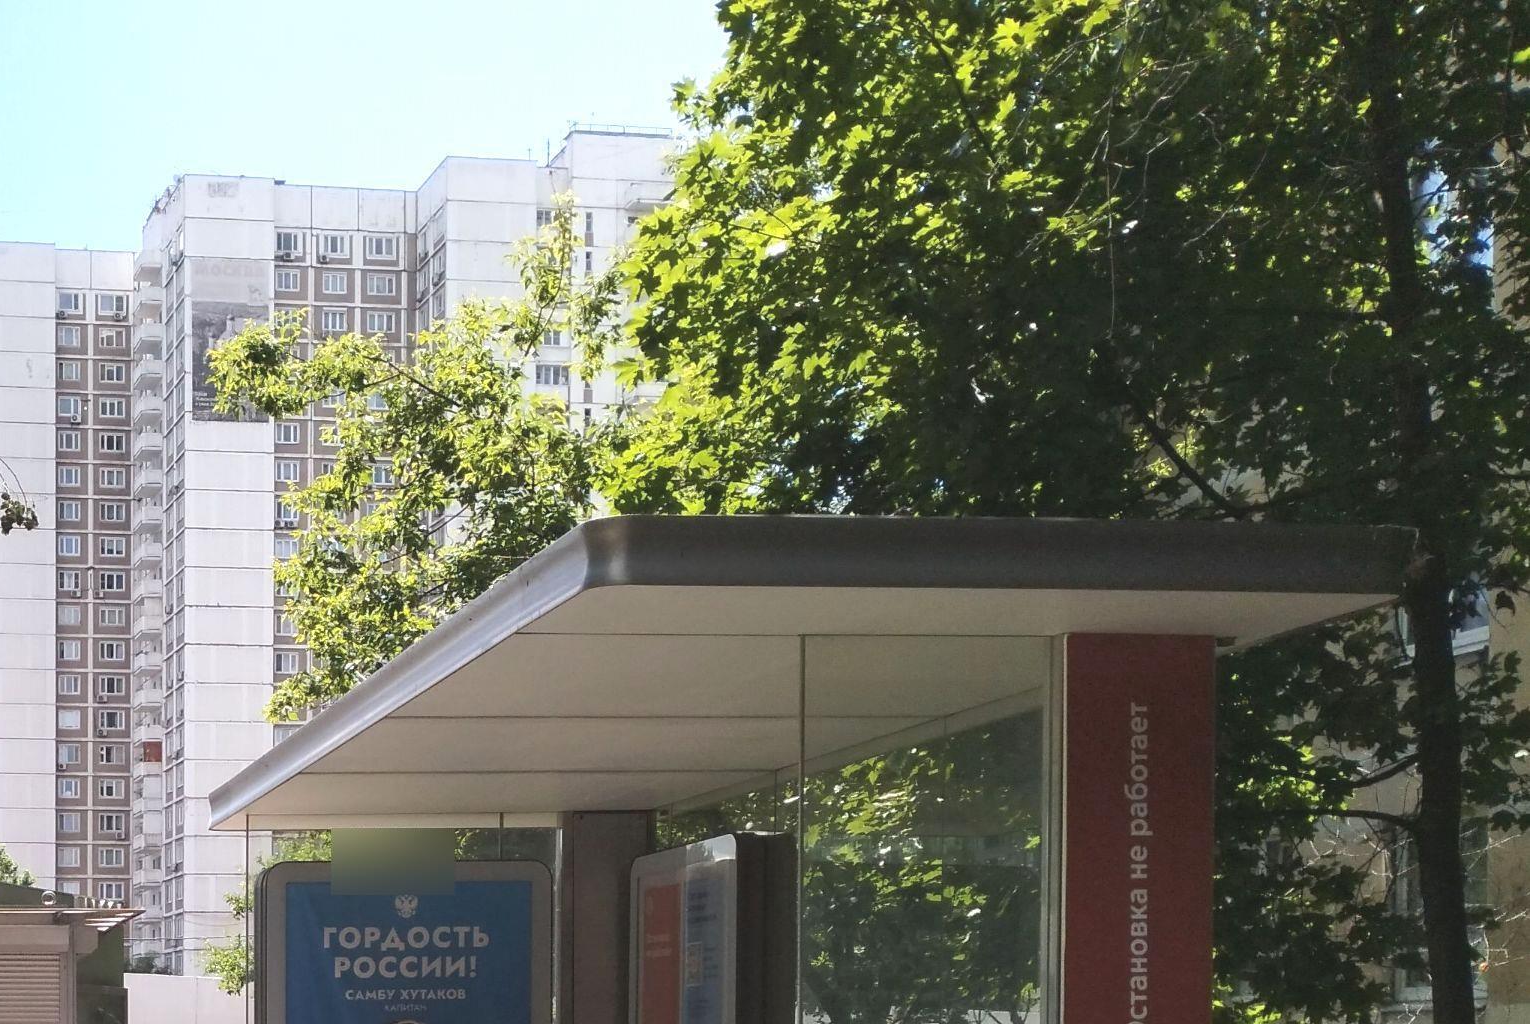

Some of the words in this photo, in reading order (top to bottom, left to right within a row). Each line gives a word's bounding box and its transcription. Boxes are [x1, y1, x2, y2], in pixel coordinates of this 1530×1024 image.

[1124, 702, 1153, 836] работает
[1131, 845, 1148, 879] не
[323, 926, 489, 951] ГОРДОСТЬ
[334, 956, 477, 979] РОССИИ!
[345, 989, 395, 1000] САМБУ
[400, 988, 466, 1000] ХУТАКОВ
[384, 1003, 427, 1012] КАПИТАН
